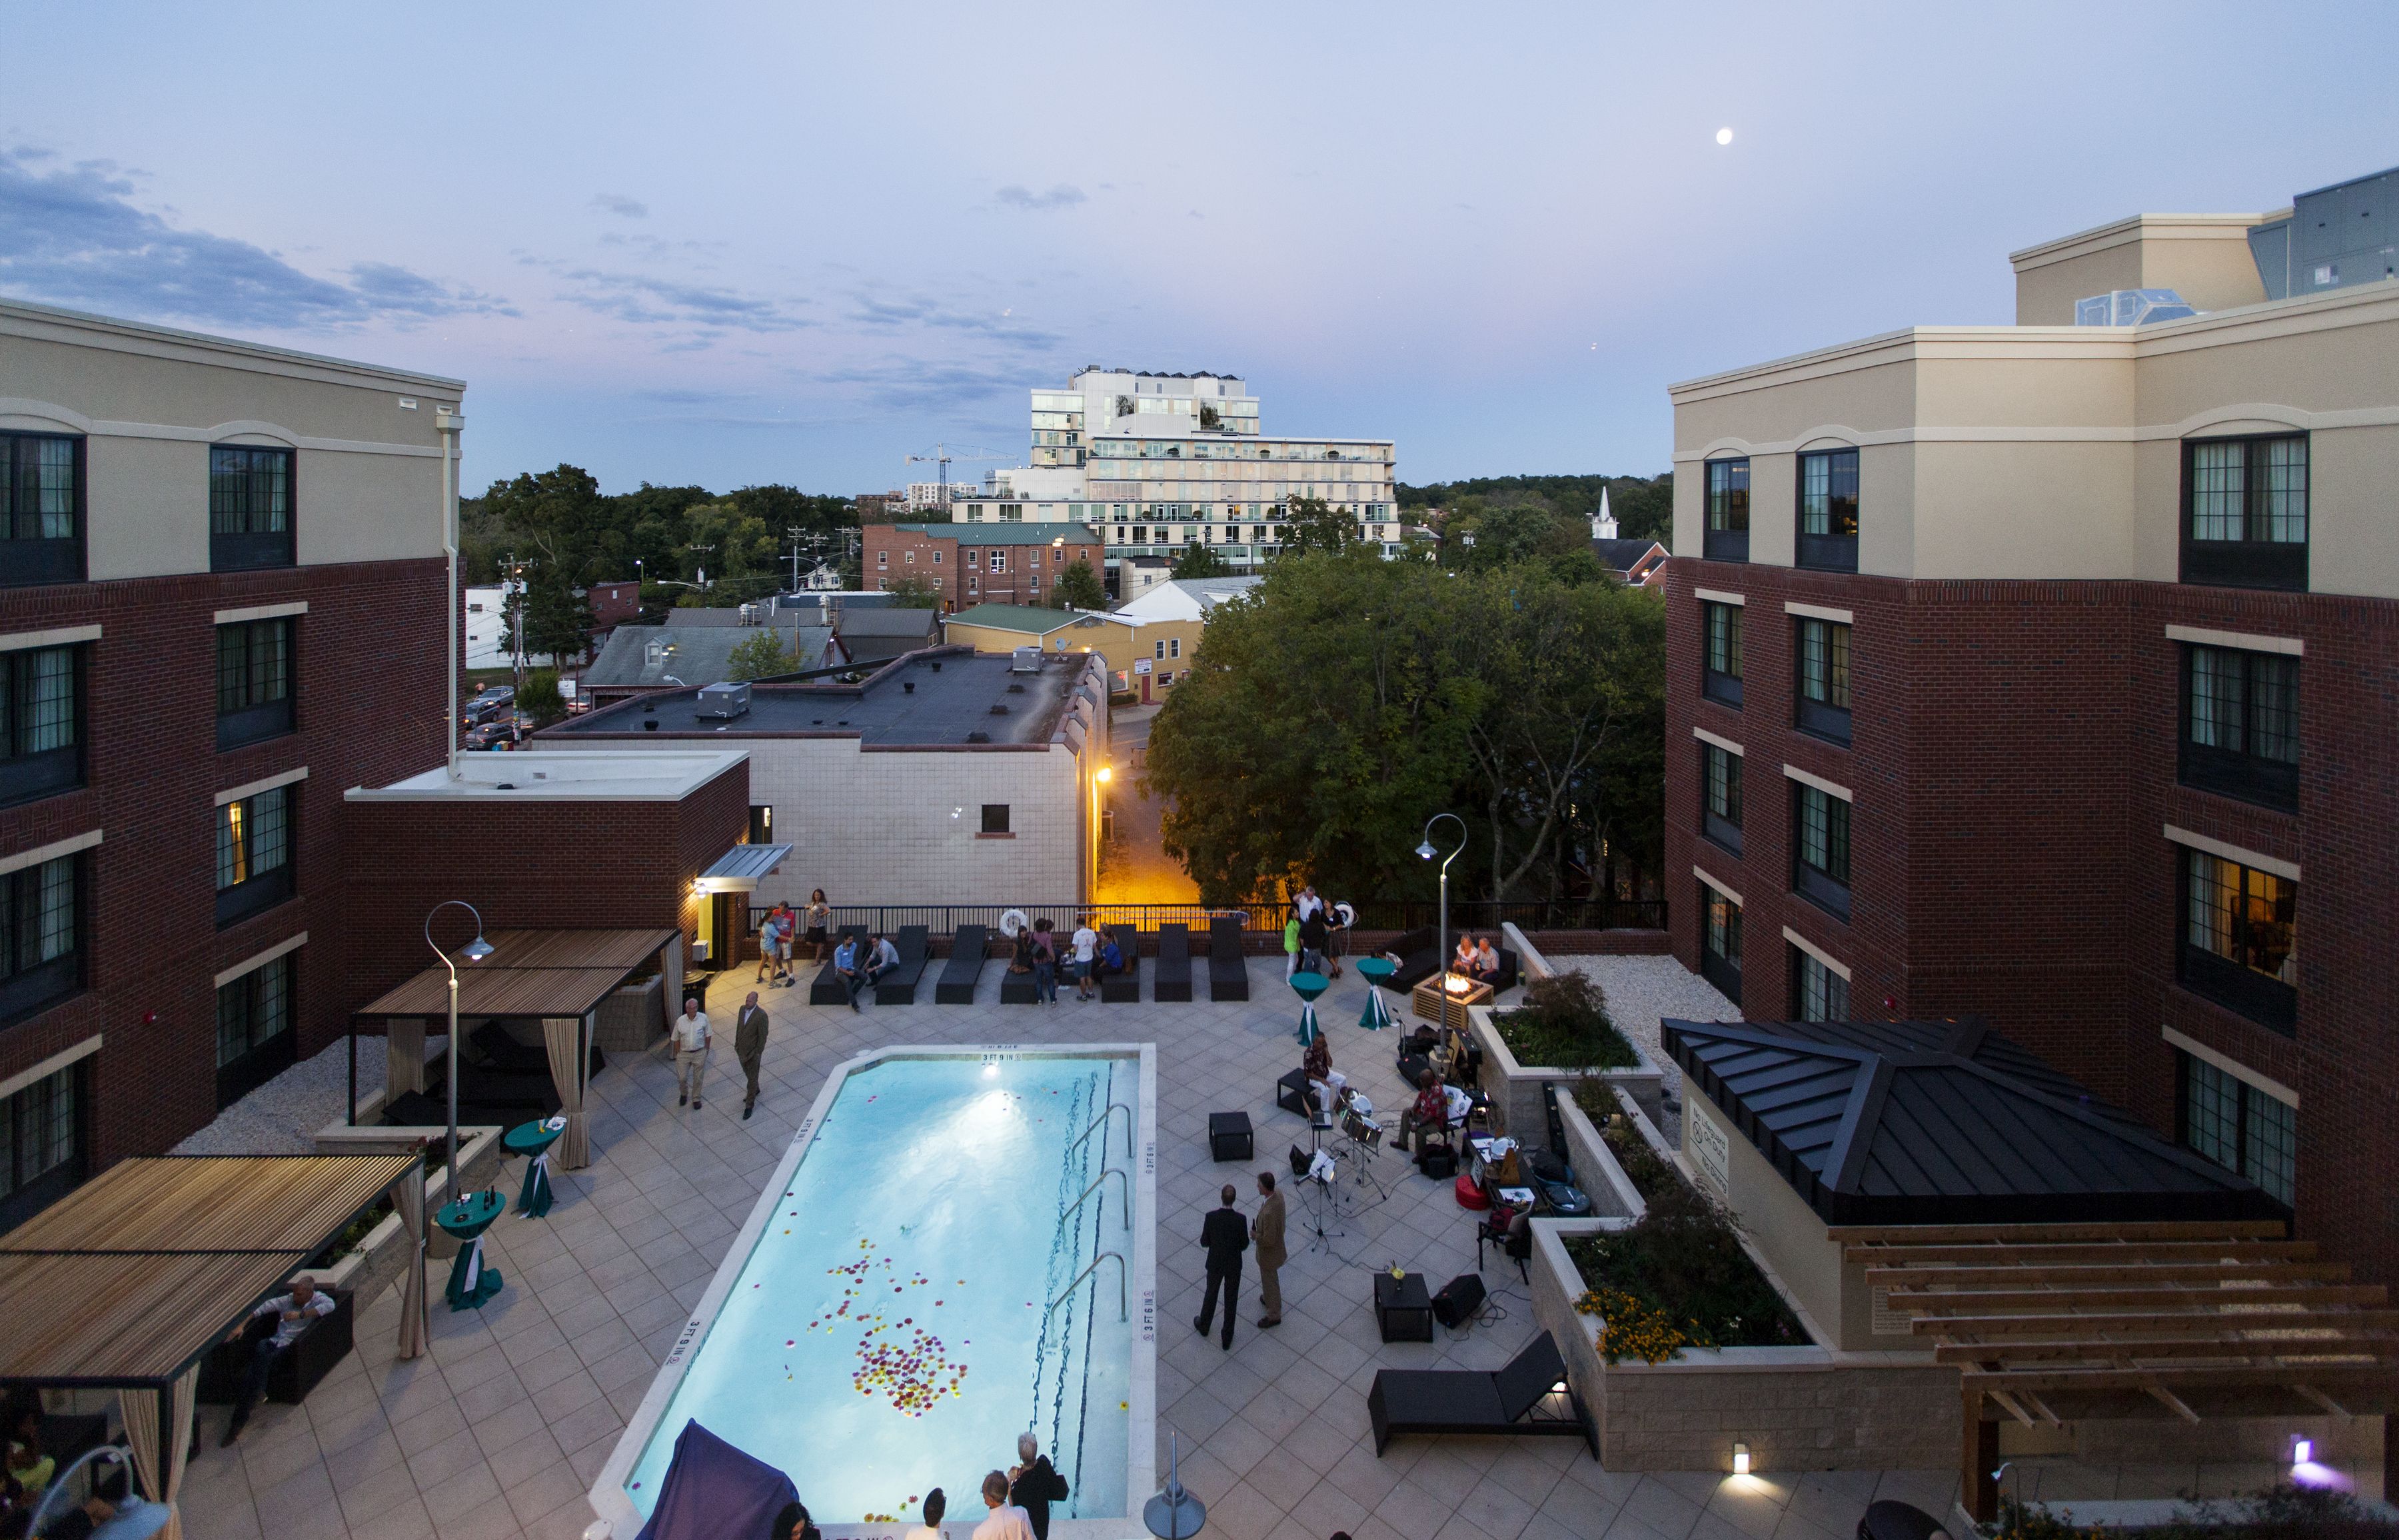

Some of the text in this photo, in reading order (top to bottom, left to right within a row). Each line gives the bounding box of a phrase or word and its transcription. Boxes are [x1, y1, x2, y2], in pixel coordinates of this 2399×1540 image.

[1693, 1108, 1726, 1150] No Lifeguard
[1704, 1132, 1725, 1163] On Duty
[1702, 1156, 1727, 1194] No Diving
[684, 1328, 696, 1337] FT
